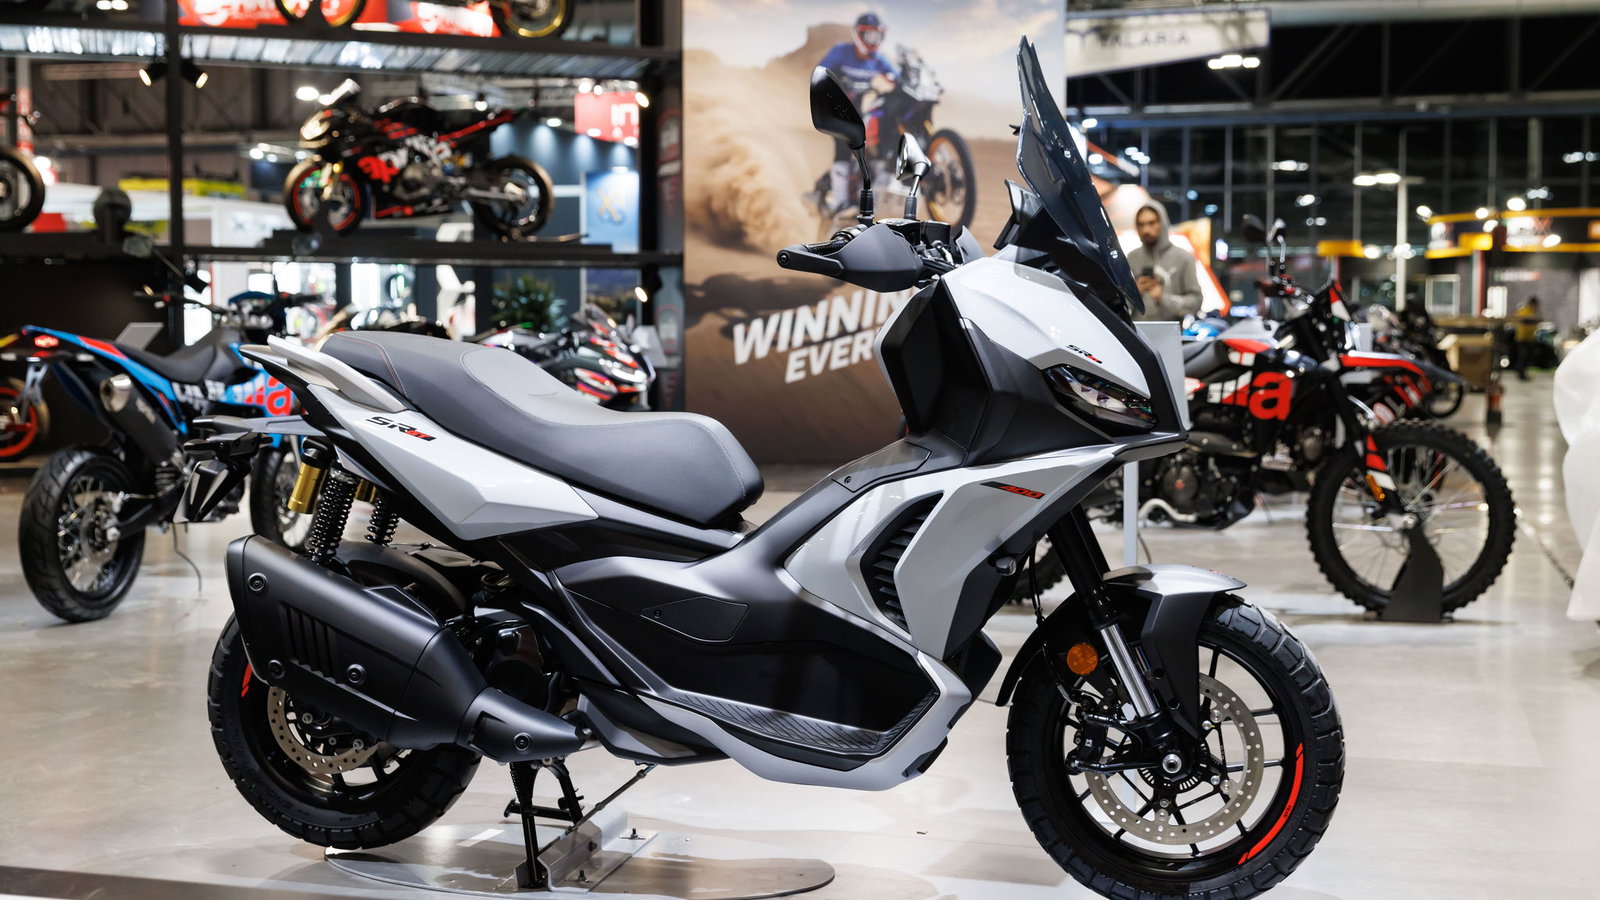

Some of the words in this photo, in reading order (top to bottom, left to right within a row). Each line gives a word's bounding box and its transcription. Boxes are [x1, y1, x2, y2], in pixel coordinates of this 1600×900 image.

[733, 288, 915, 365] WINNIN
[785, 328, 878, 384] EVER
[1000, 485, 1044, 499] 400
